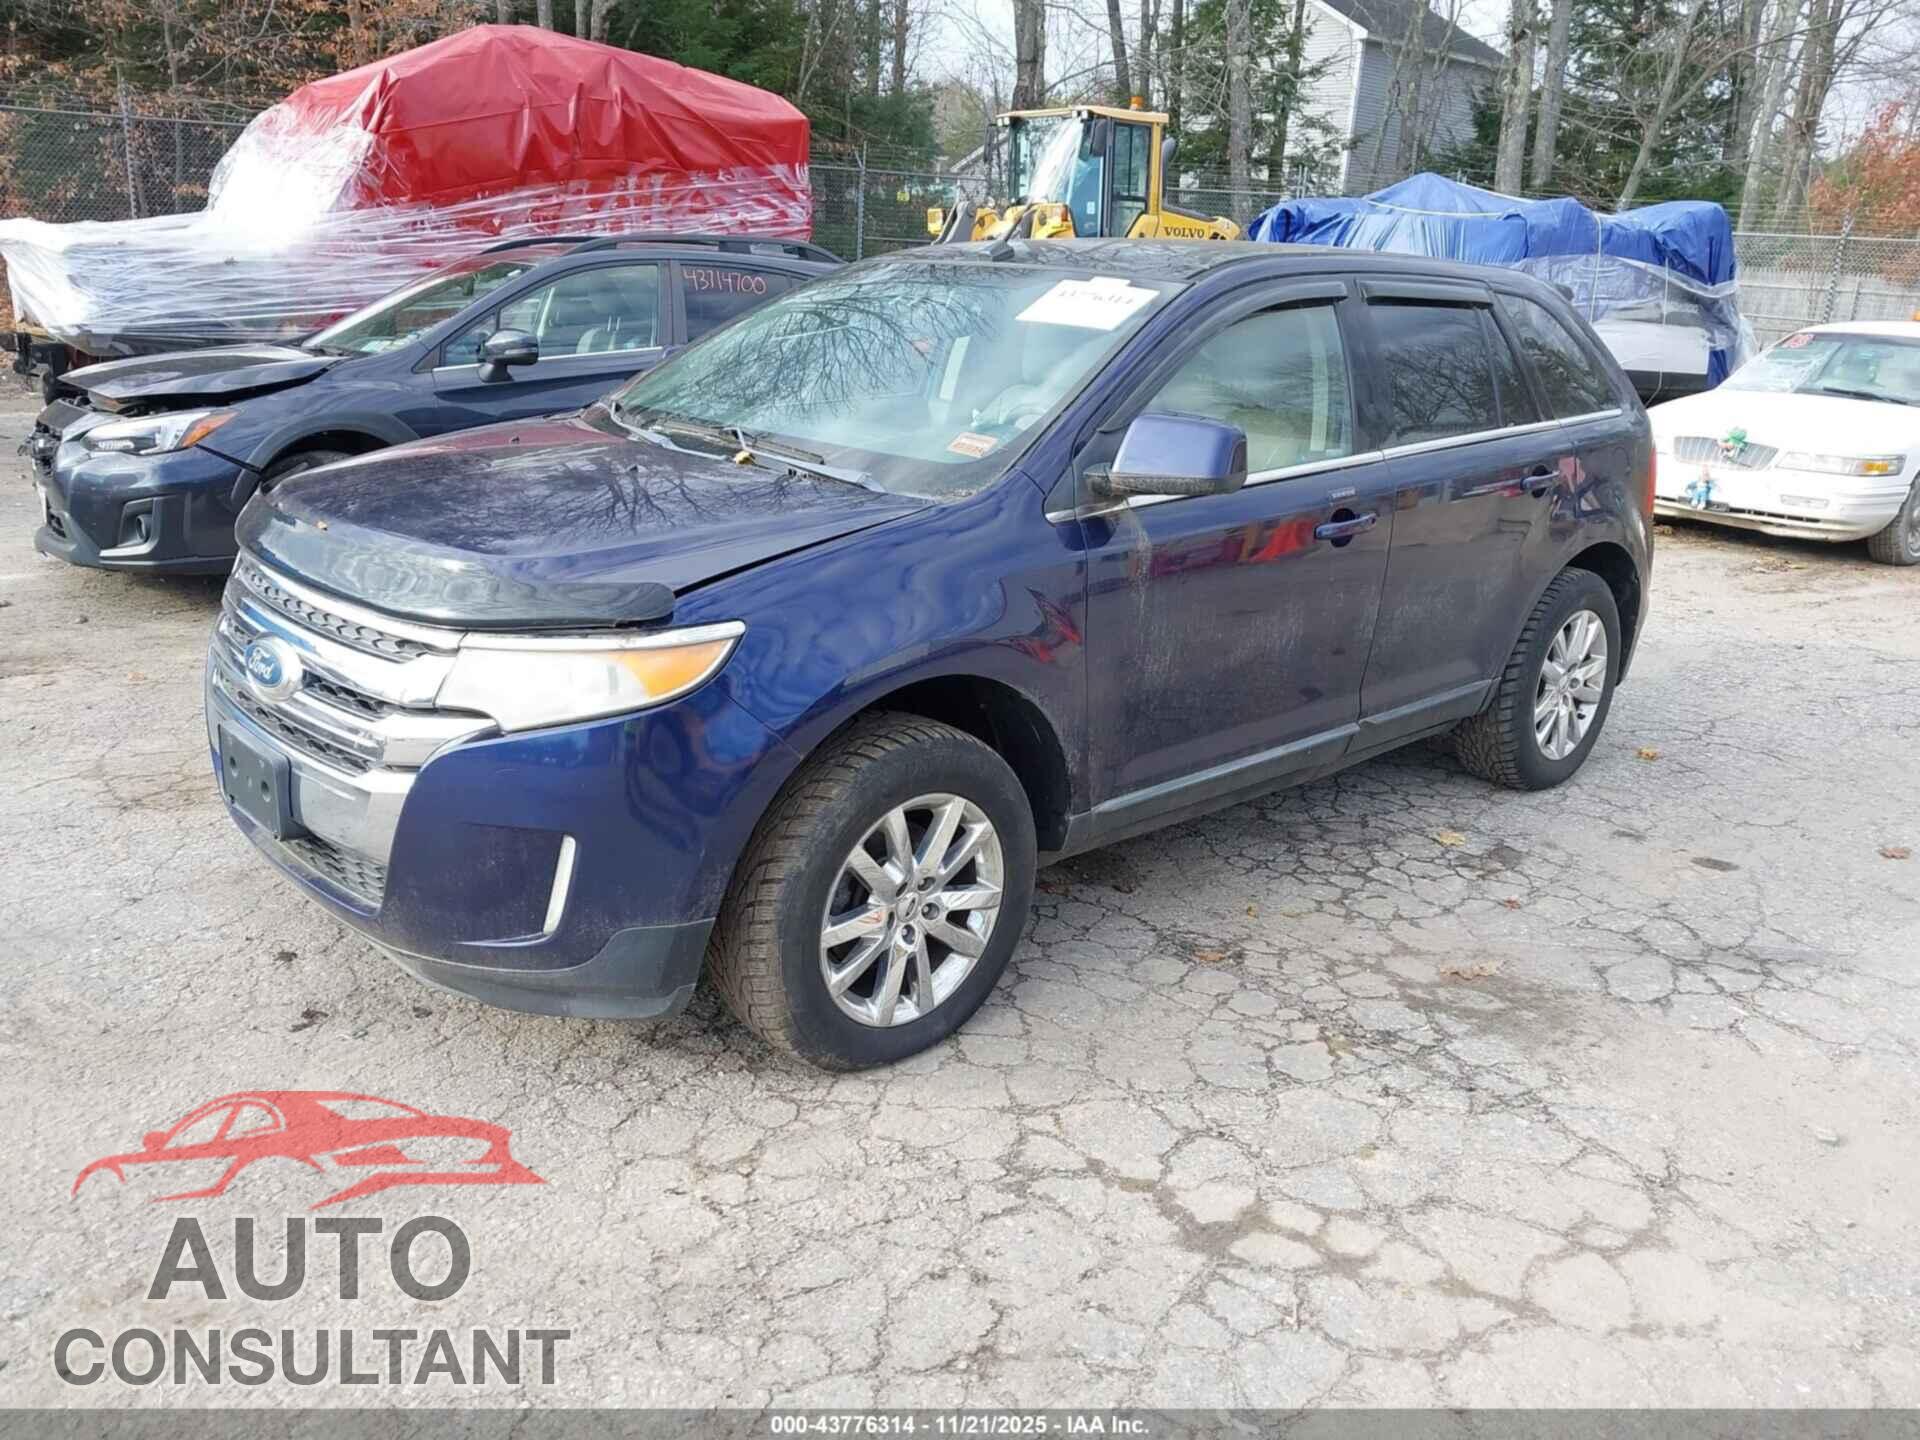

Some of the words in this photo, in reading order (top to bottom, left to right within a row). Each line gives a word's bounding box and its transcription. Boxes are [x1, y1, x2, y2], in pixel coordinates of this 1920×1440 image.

[1163, 226, 1205, 239] VOLVO
[682, 266, 767, 295] 43714700
[248, 647, 275, 680] Ford
